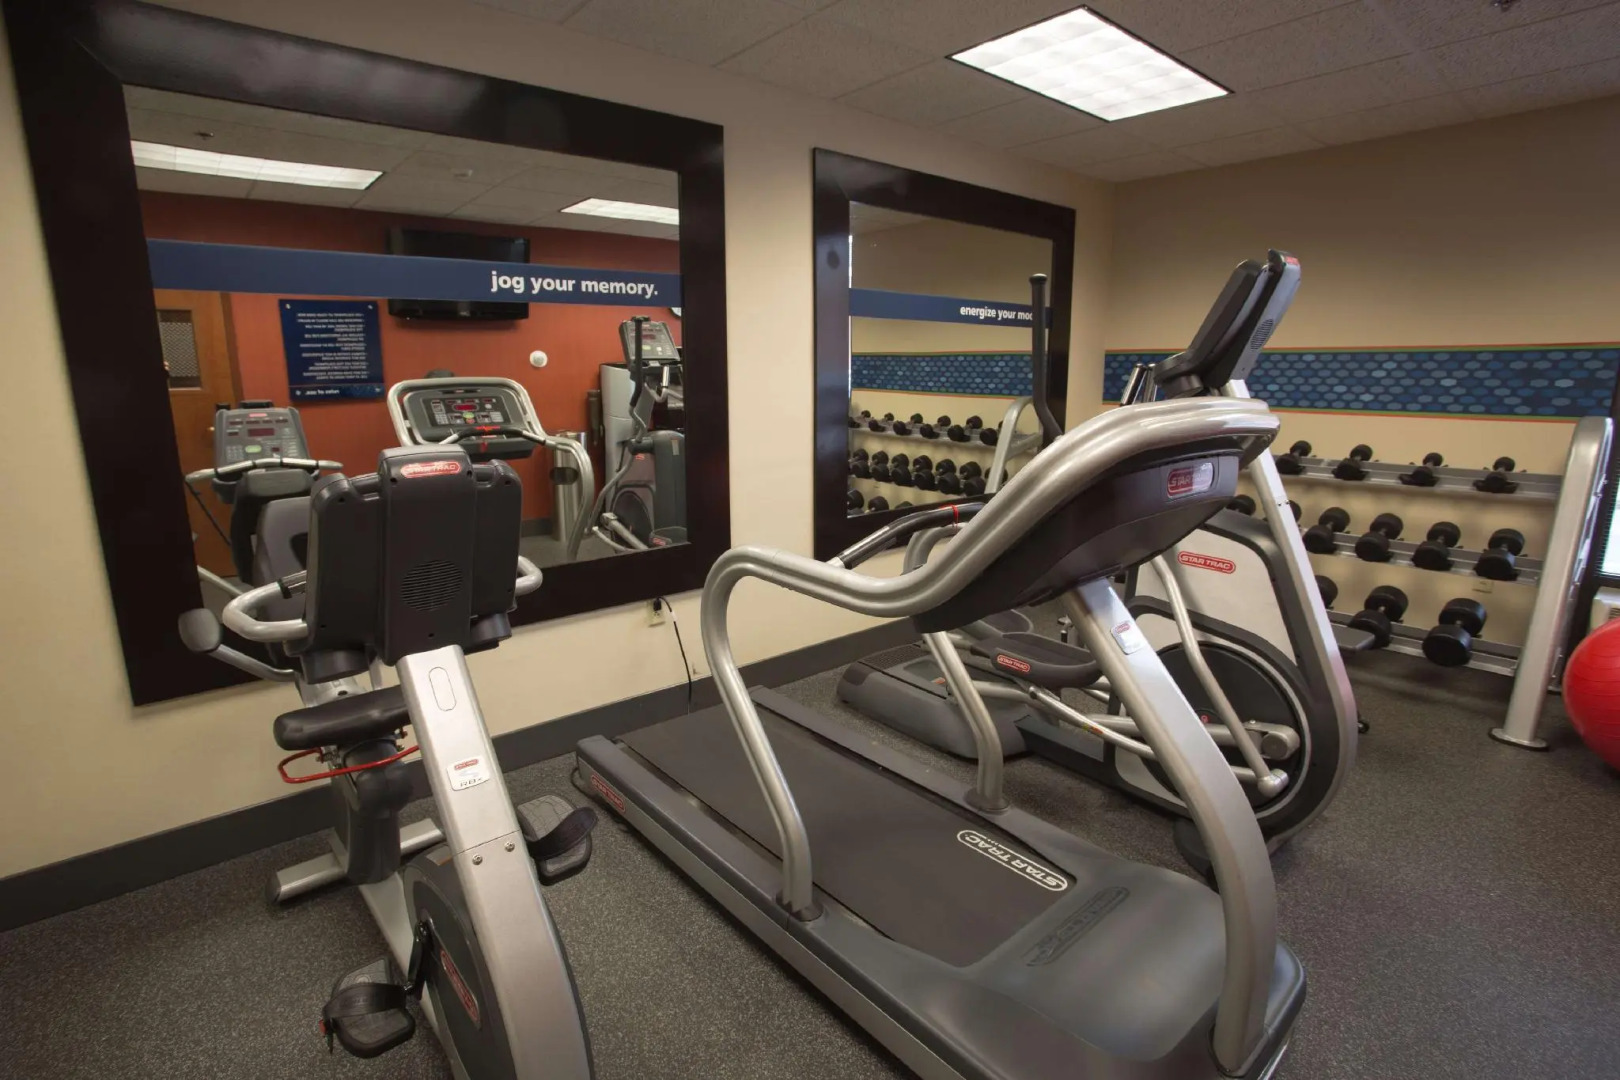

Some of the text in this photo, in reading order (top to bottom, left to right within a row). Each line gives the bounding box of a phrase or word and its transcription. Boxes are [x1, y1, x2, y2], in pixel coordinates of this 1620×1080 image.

[491, 271, 658, 299] jog your memory.
[960, 306, 996, 319] energize
[998, 309, 1017, 321] your
[1170, 474, 1192, 487] STAR
[1181, 555, 1231, 570] STAR TRAC
[1000, 657, 1028, 670] STAR TRAC
[965, 834, 1058, 887] STAR TRAC
